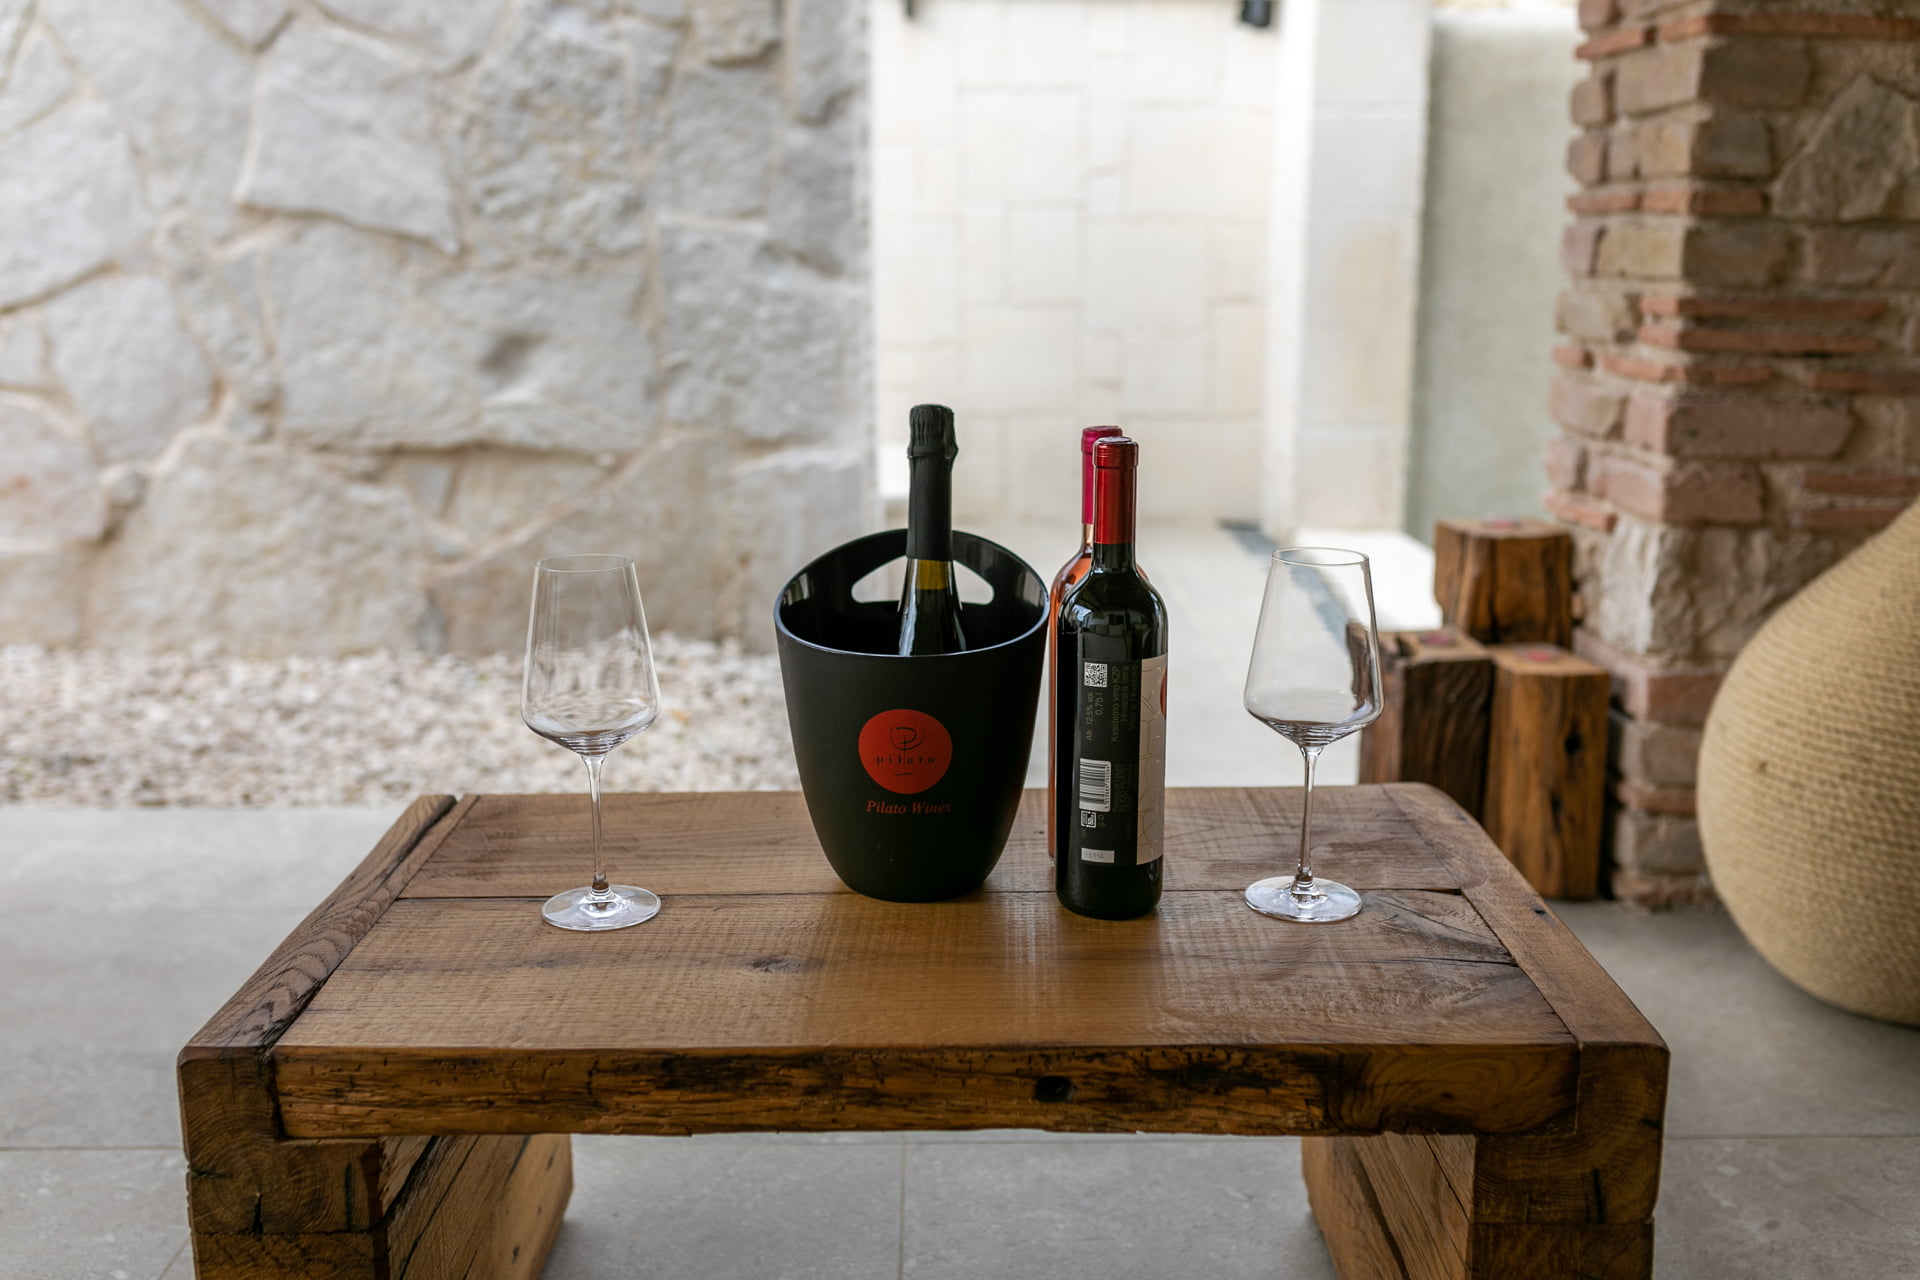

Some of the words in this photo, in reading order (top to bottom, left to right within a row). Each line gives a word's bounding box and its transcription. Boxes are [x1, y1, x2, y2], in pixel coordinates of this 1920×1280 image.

[1095, 697, 1104, 716] 0,75
[866, 800, 907, 814] Pilato
[912, 802, 952, 814] Wines
